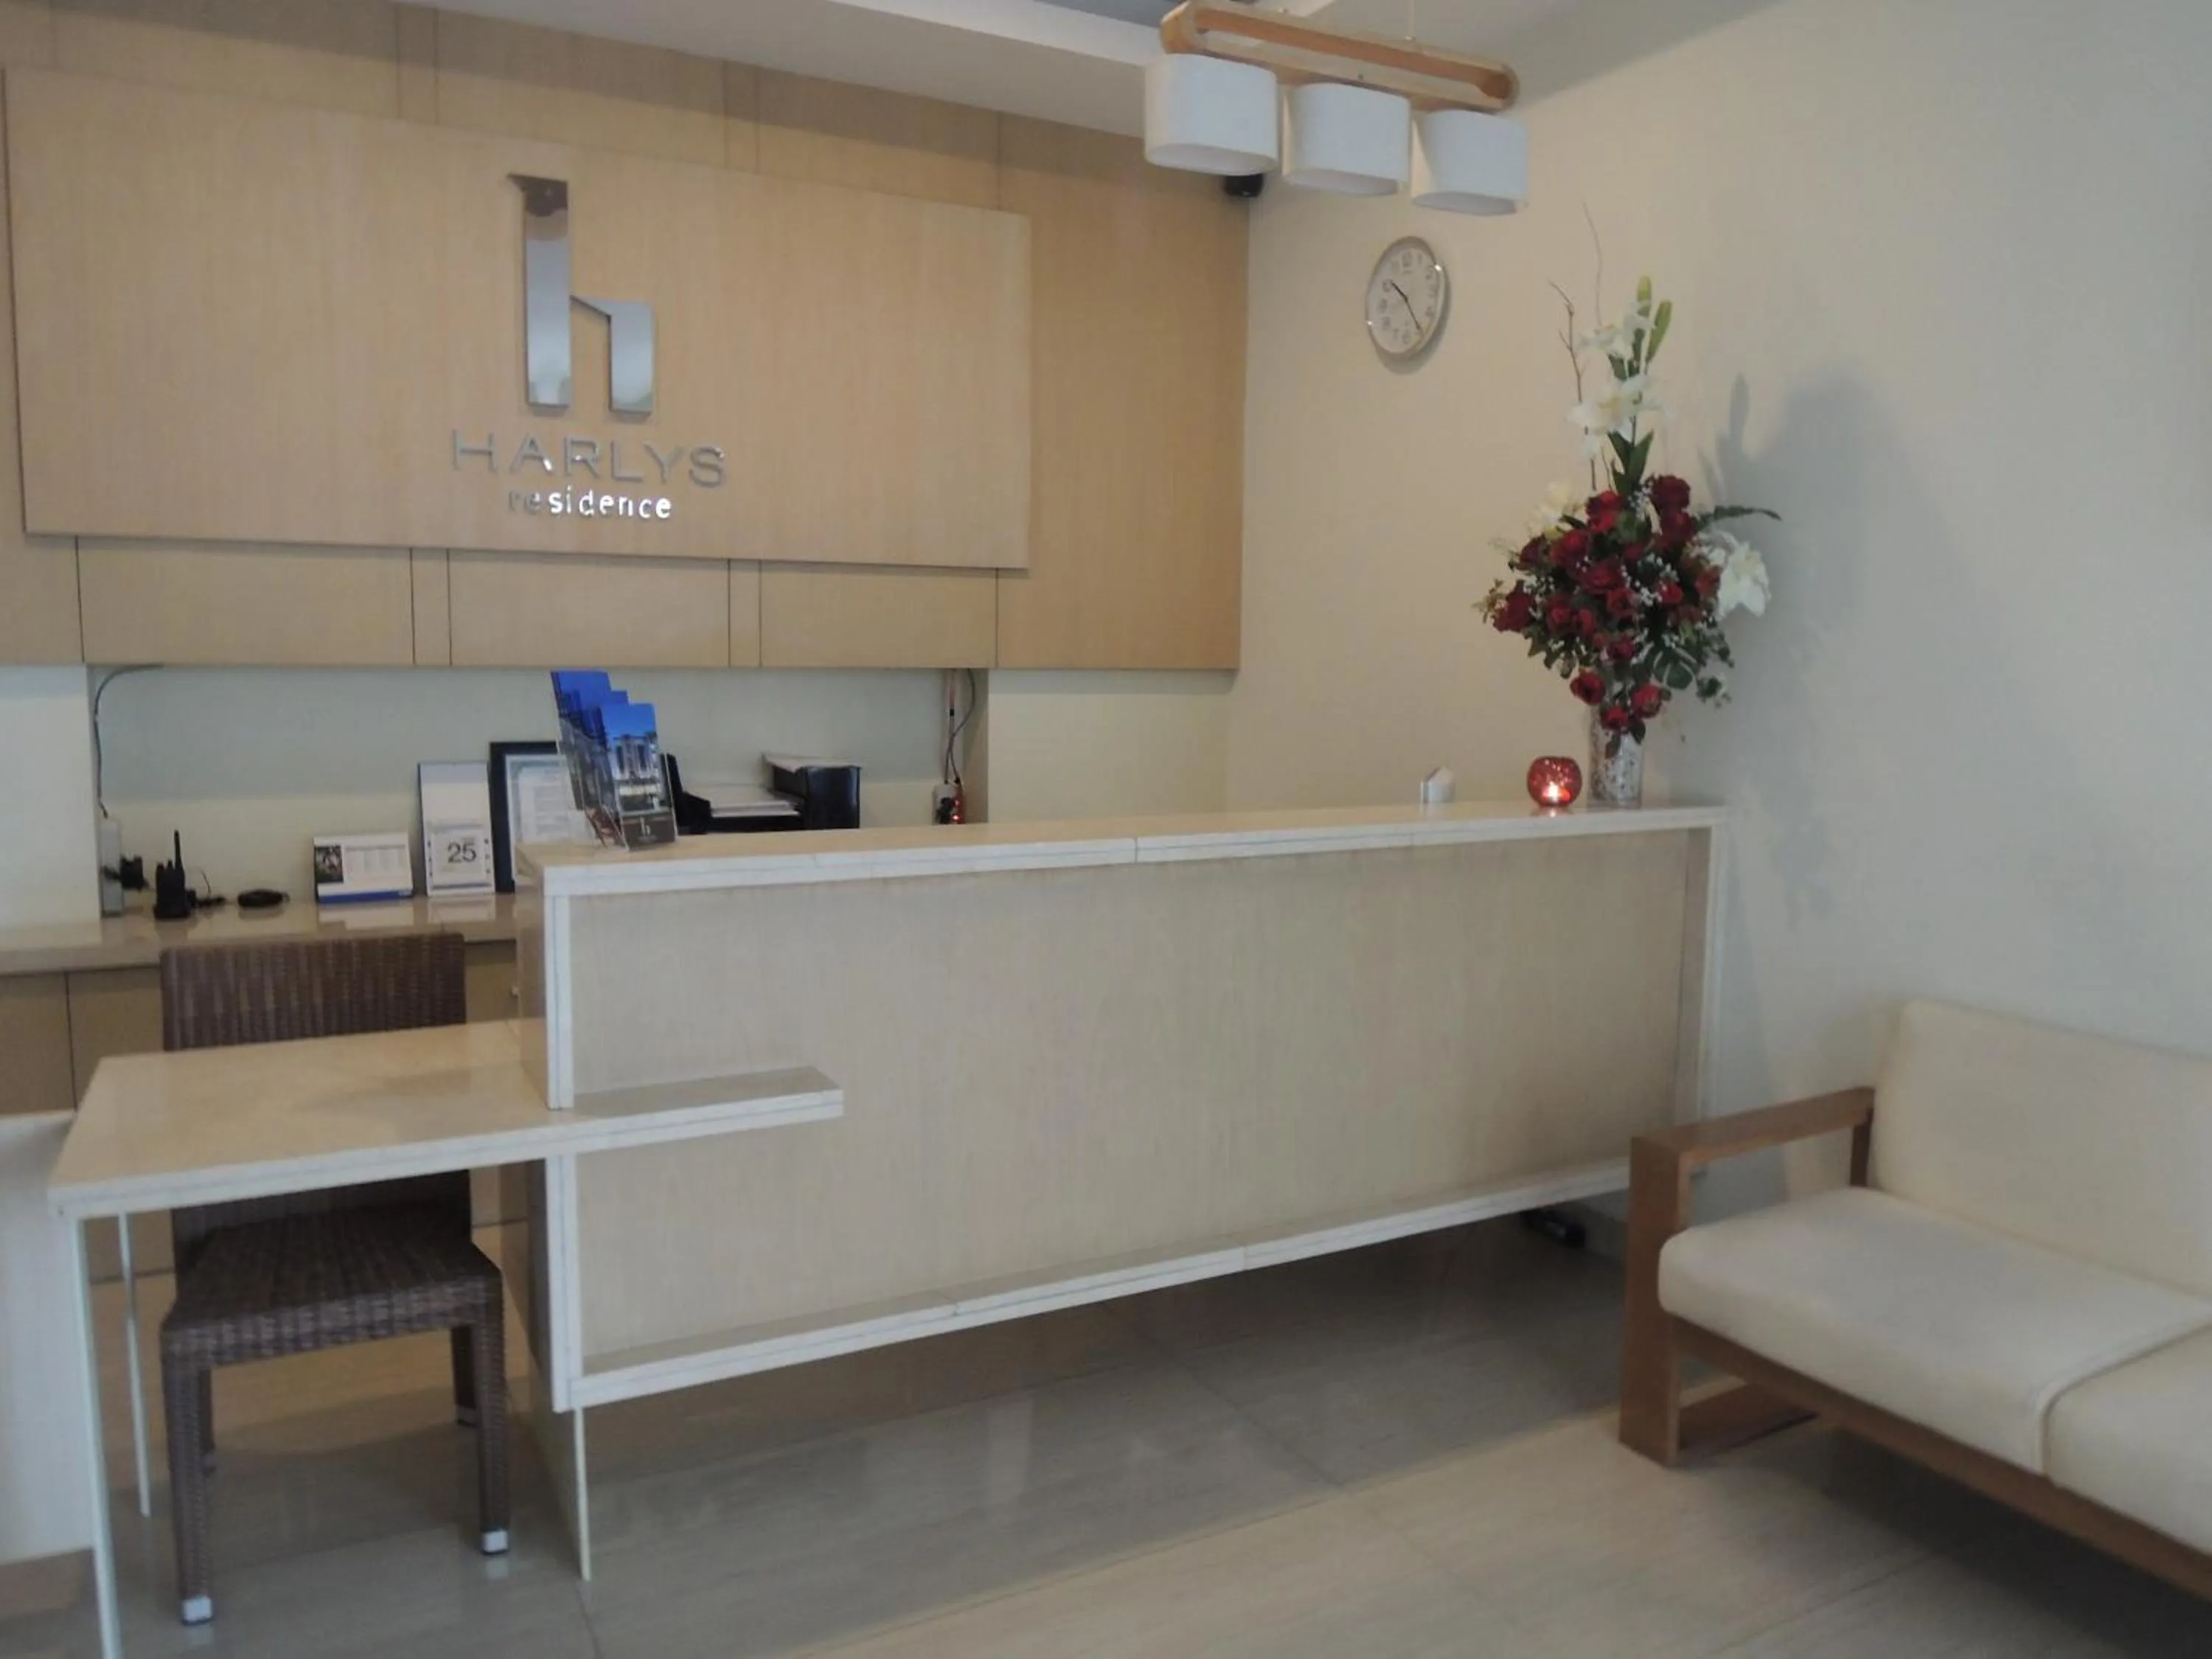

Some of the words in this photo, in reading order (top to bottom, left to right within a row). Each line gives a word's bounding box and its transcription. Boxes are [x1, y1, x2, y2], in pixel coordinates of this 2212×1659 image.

[452, 429, 725, 488] HARLYS
[509, 485, 672, 519] residence
[447, 841, 478, 864] 25
